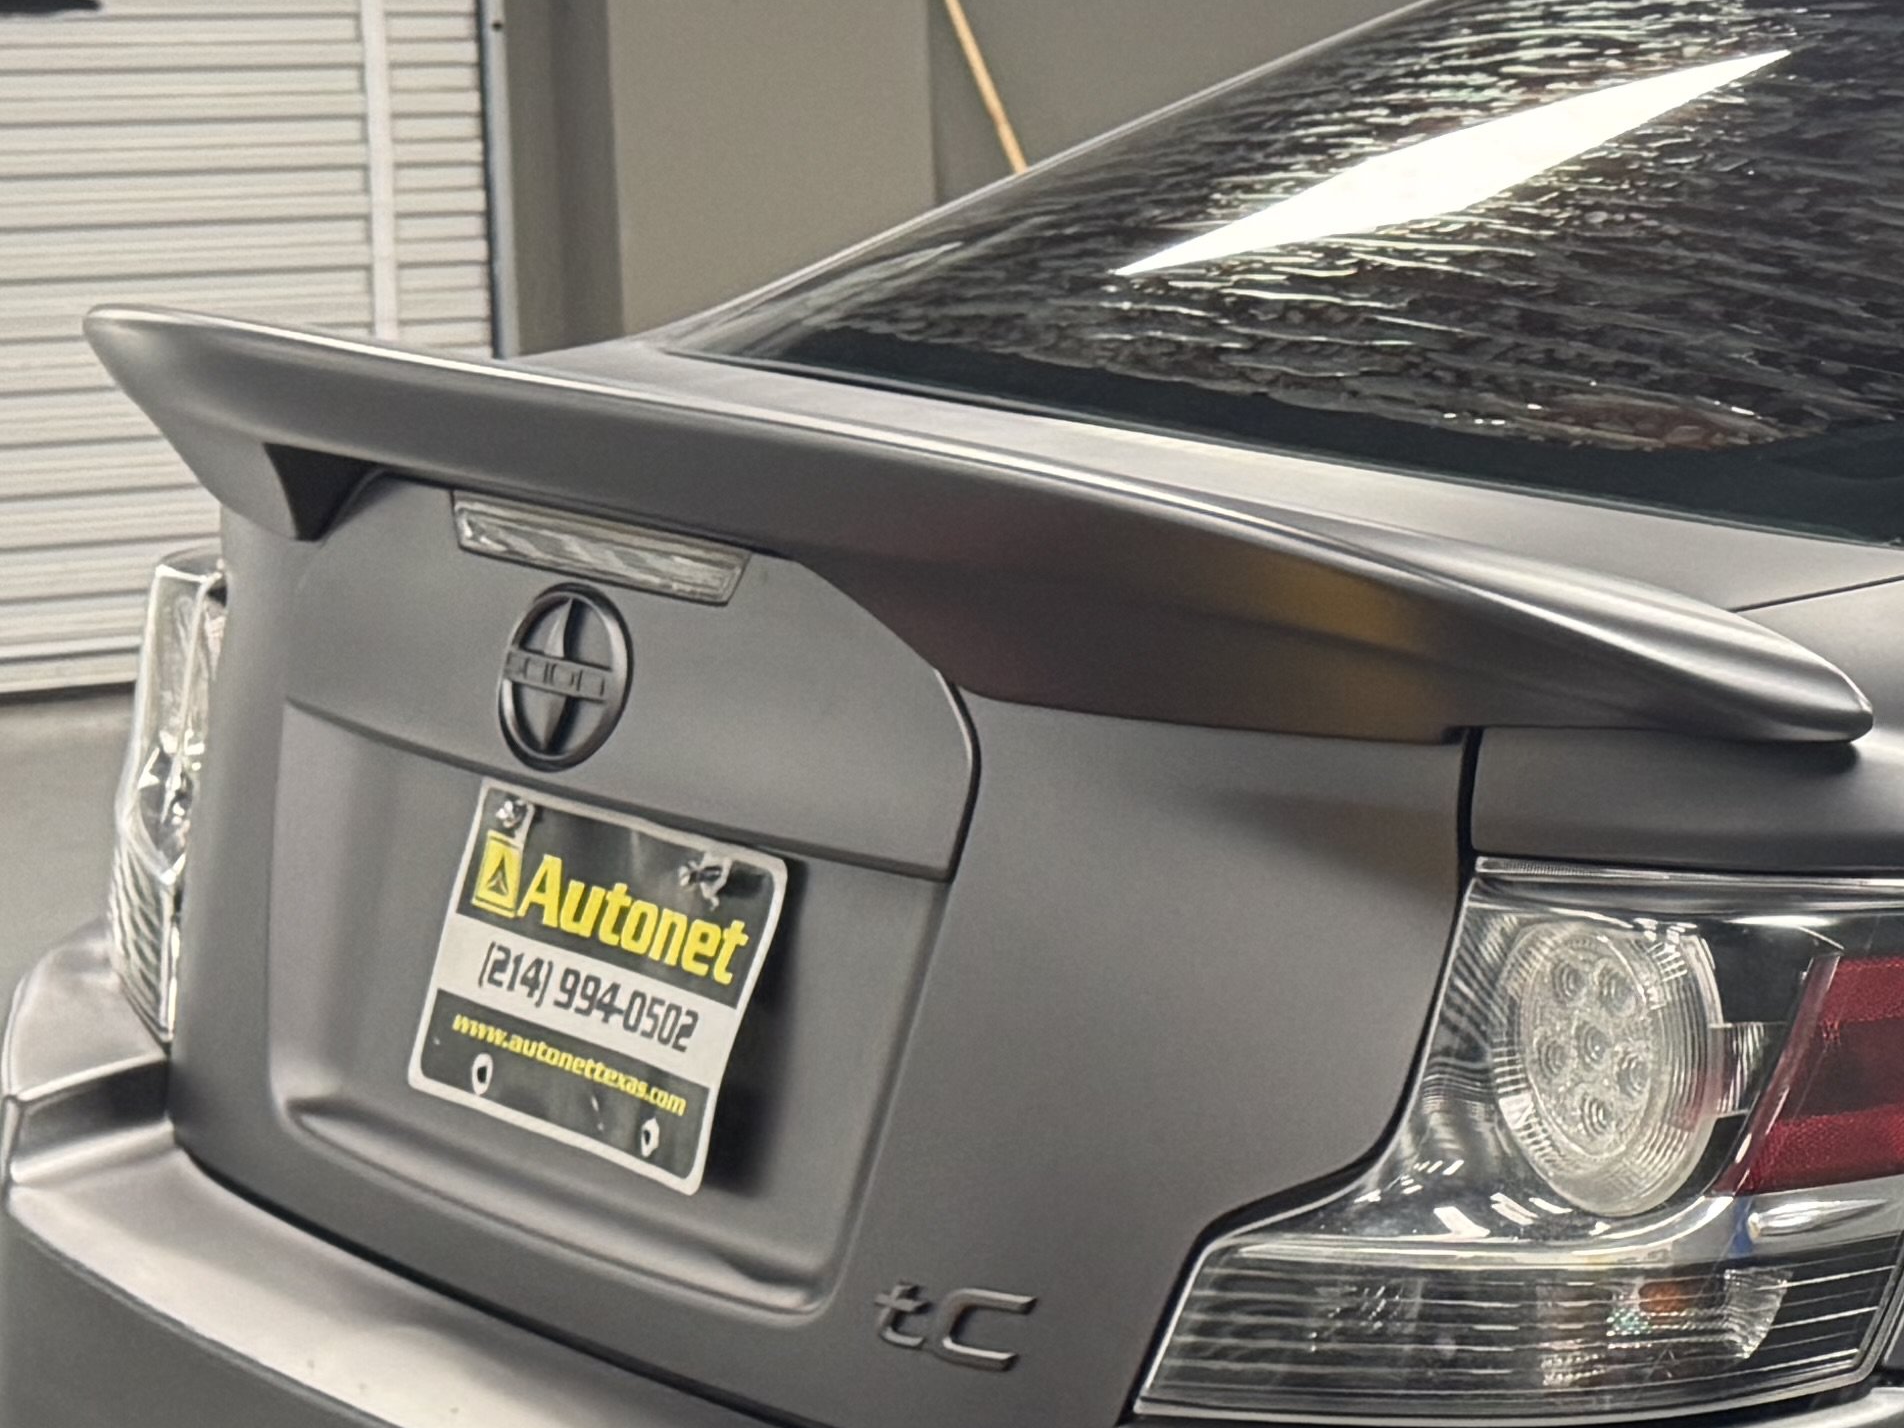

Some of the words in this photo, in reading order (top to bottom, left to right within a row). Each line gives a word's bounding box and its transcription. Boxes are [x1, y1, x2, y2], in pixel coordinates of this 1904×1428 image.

[516, 854, 748, 985] Autonet
[478, 941, 553, 1009] (214)
[553, 967, 699, 1052] 994-0502
[452, 1014, 687, 1117] www.autonettexas.com
[874, 1281, 1039, 1371] tC
